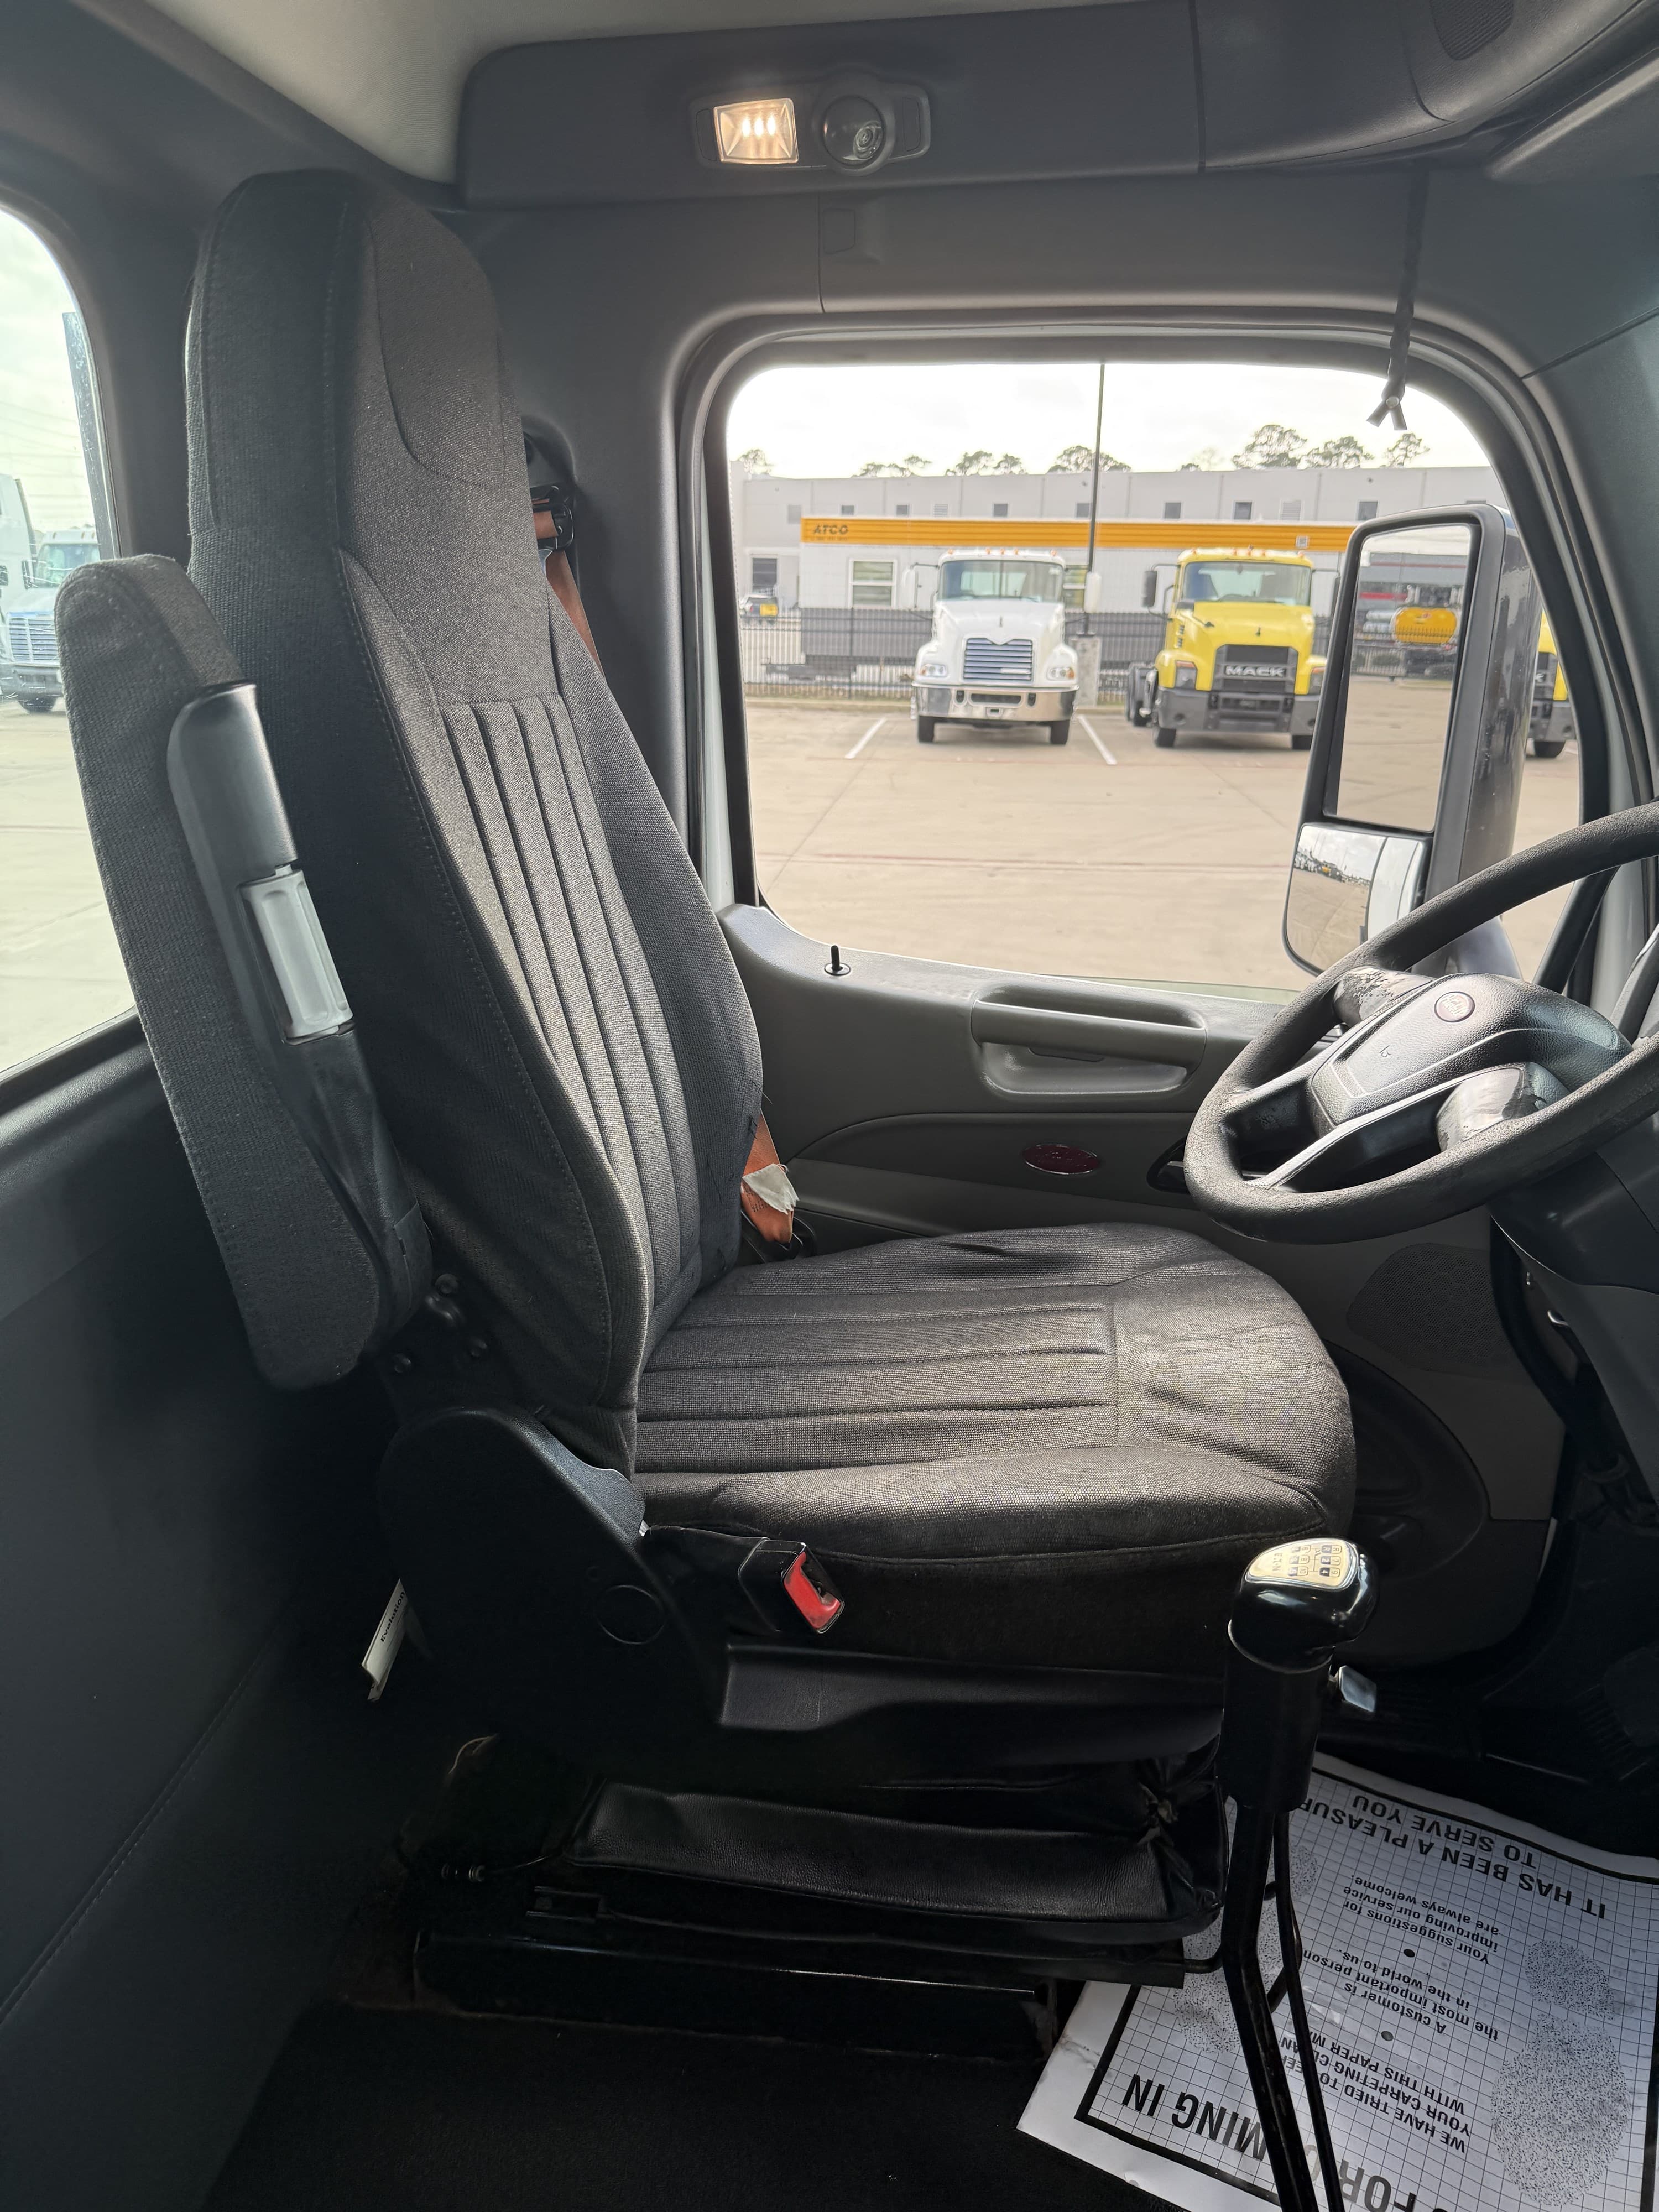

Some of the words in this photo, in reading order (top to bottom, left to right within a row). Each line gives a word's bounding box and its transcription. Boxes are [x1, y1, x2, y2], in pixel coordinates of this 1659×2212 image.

[813, 524, 848, 535] ATCO
[1225, 665, 1284, 677] MACK
[380, 1592, 405, 1642] Evolution
[1352, 1795, 1402, 1824] YOU
[1298, 1798, 1408, 1848] PLEASUR
[1411, 1815, 1494, 1852] SERVE
[1418, 1839, 1434, 1855] A
[1504, 1844, 1536, 1869] TO
[1442, 1847, 1509, 1882] BEEN
[1343, 1887, 1394, 1910] service
[1351, 1875, 1416, 1904] welcome.
[1518, 1873, 1572, 1906] HAS
[1343, 1901, 1363, 1915] for
[1397, 1905, 1421, 1919] our
[1421, 1900, 1471, 1924] always
[1580, 1898, 1605, 1919] IT
[1366, 1910, 1453, 1948] suggestions
[1425, 1914, 1498, 1952] improving
[1475, 1921, 1499, 1936] are
[1302, 1950, 1353, 1976] person
[1338, 1949, 1359, 1964] us.
[1457, 1942, 1489, 1964] Your
[1363, 1961, 1377, 1973] to
[1381, 1967, 1423, 1990] world
[1344, 1983, 1357, 1996] is
[1355, 1973, 1427, 2010] important
[1427, 1986, 1451, 2002] the
[1361, 1990, 1431, 2025] customer
[1432, 2003, 1469, 2026] most
[1455, 1997, 1470, 2011] in
[1436, 2021, 1447, 2034] A
[1474, 2022, 1498, 2041] the
[1330, 2042, 1379, 2073] PAPER
[1320, 2073, 1338, 2090] TO
[1334, 2061, 1421, 2110] CARPETING
[1384, 2067, 1418, 2092] THIS
[1122, 2074, 1165, 2117] IN
[1344, 2084, 1389, 2115] TRIED
[1424, 2085, 1464, 2115] WITH
[1394, 2107, 1436, 2137] HAVE
[1426, 2105, 1469, 2136] YOUR
[1440, 2131, 1465, 2153] WE
